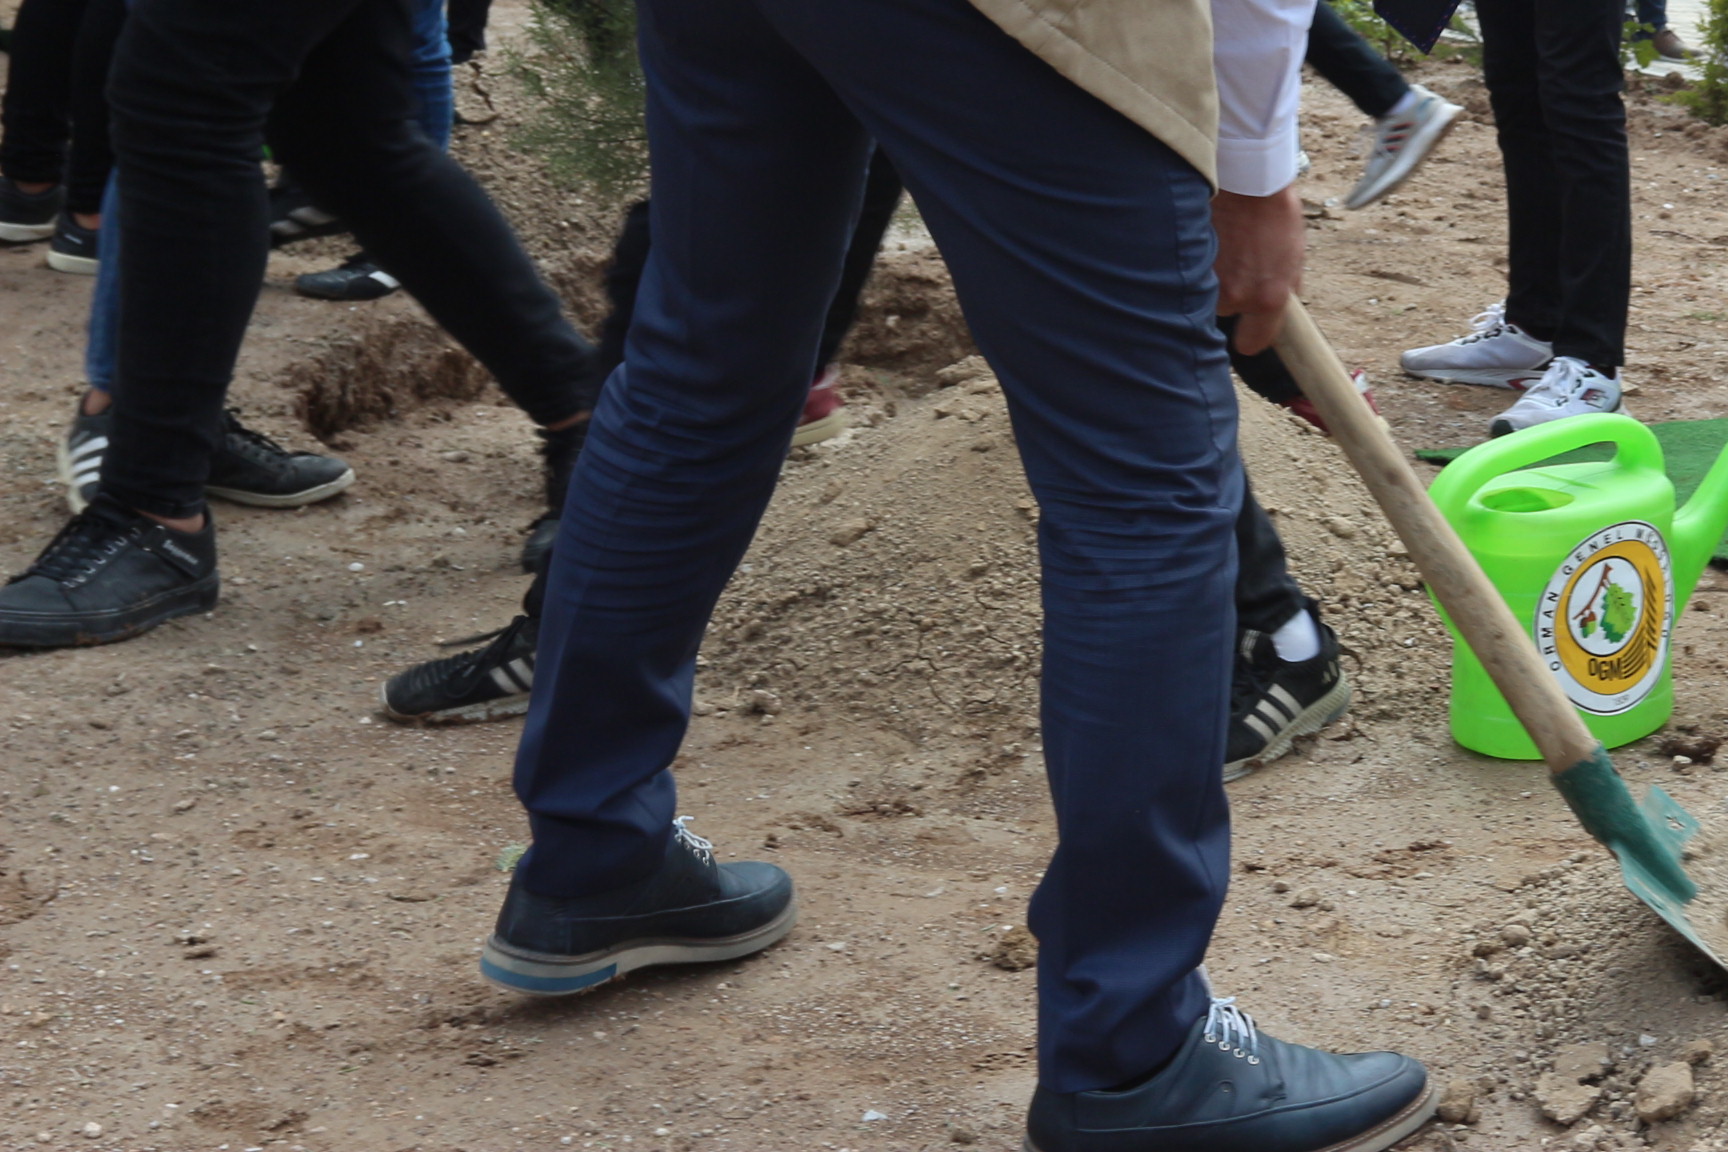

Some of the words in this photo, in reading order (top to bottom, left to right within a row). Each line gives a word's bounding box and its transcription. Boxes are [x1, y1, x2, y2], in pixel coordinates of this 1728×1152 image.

[1542, 591, 1562, 672] ORMAN
[1562, 529, 1625, 576] GENEL
[1587, 657, 1625, 682] OGM
